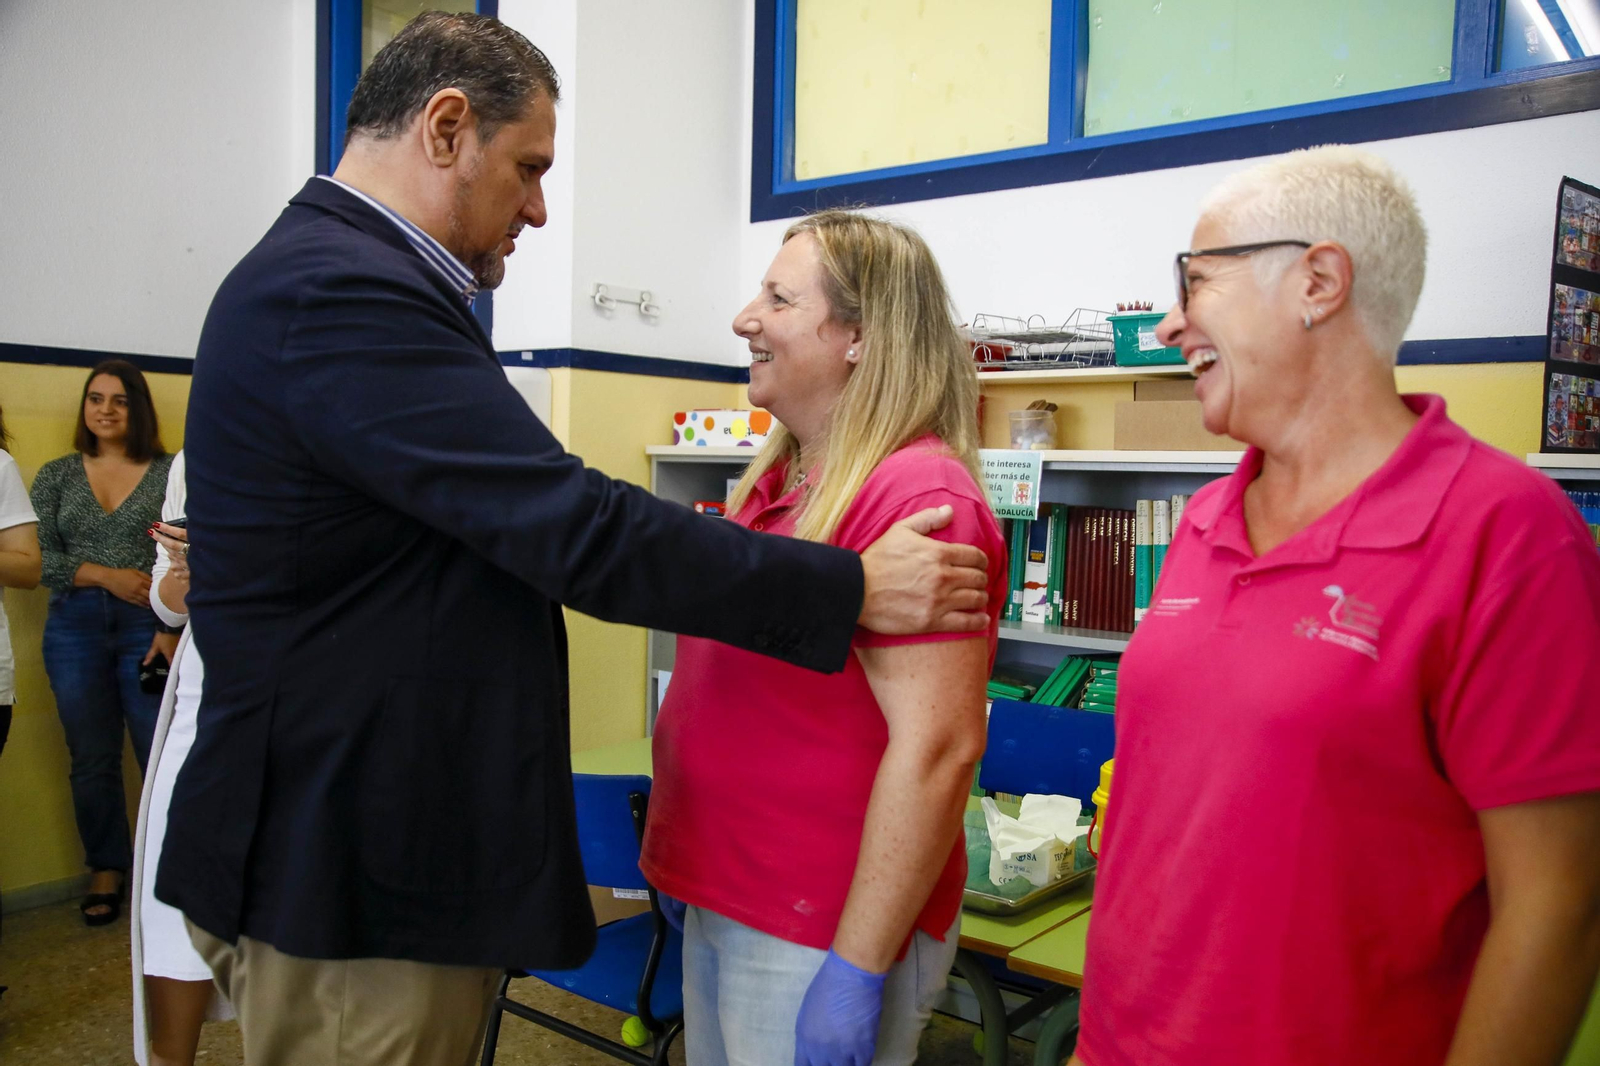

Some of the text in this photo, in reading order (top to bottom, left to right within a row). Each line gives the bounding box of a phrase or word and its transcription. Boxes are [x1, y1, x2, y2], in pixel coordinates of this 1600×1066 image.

[997, 459, 1031, 468] interesa
[1001, 472, 1018, 480] más
[992, 507, 1034, 517] NDALUCÍA
